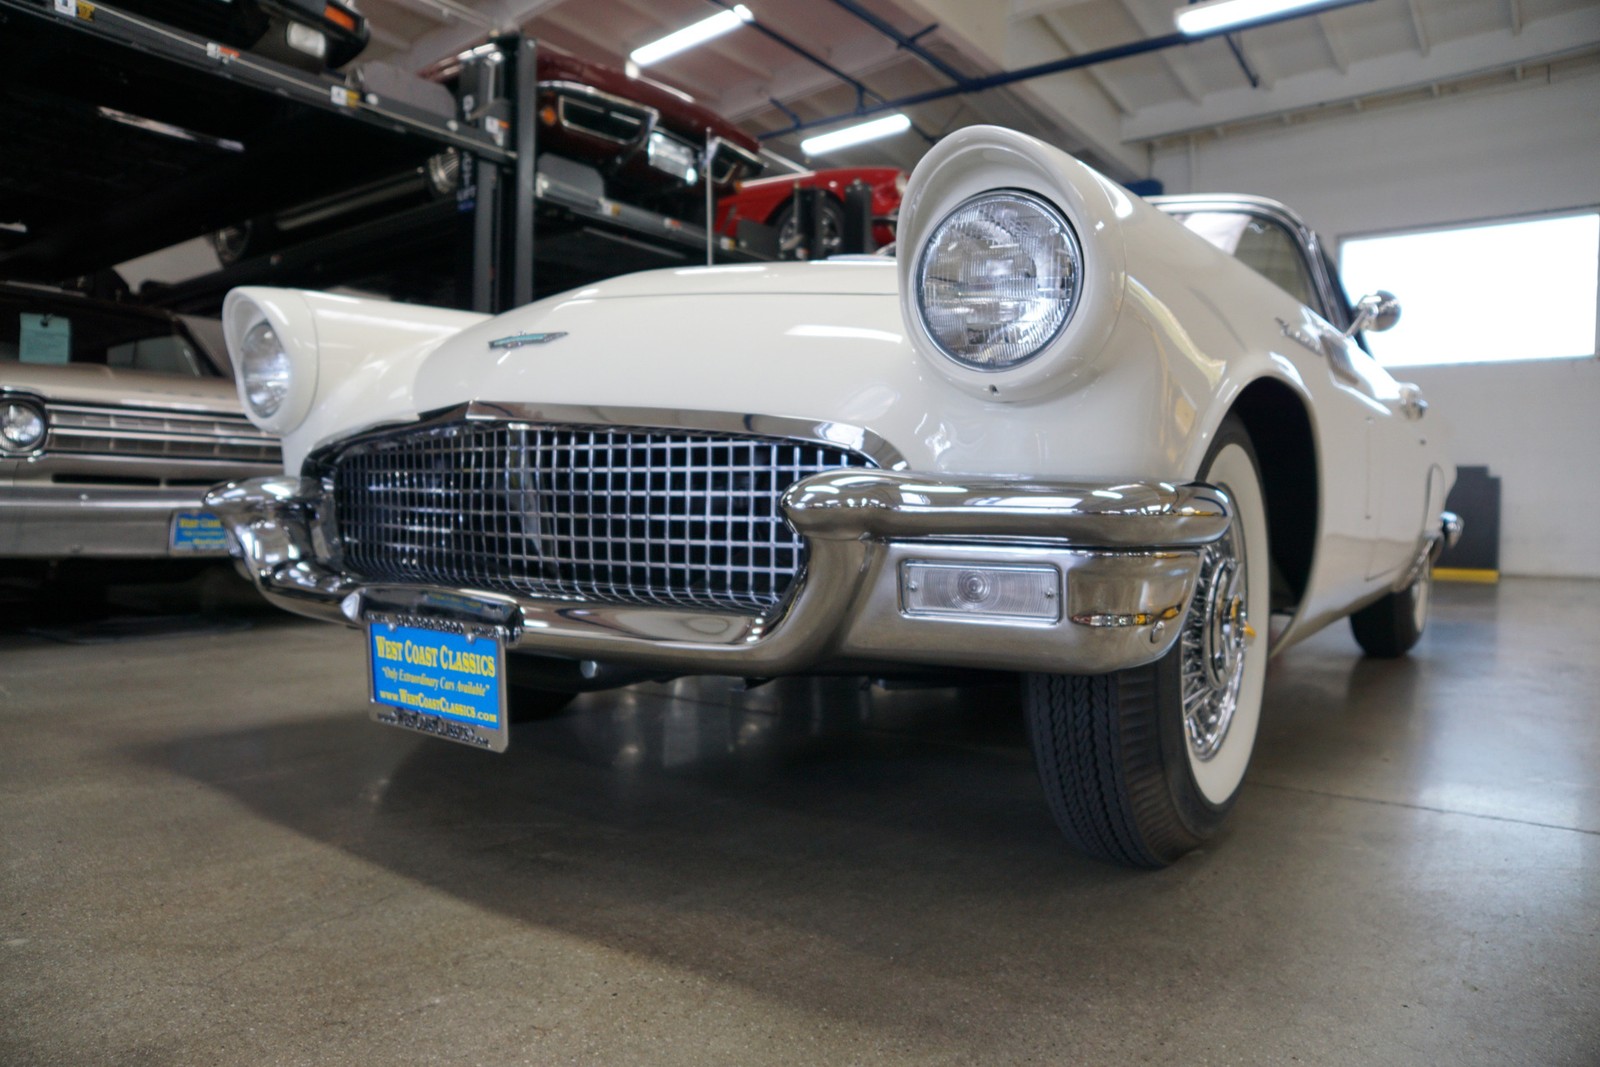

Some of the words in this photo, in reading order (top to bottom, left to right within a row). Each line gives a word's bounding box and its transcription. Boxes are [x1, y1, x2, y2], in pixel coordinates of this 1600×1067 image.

[376, 636, 403, 661] WEST
[405, 640, 438, 667] COAST
[440, 645, 495, 678] CLASSICS
[399, 669, 439, 690] Extraordinary
[440, 677, 454, 690] Cars
